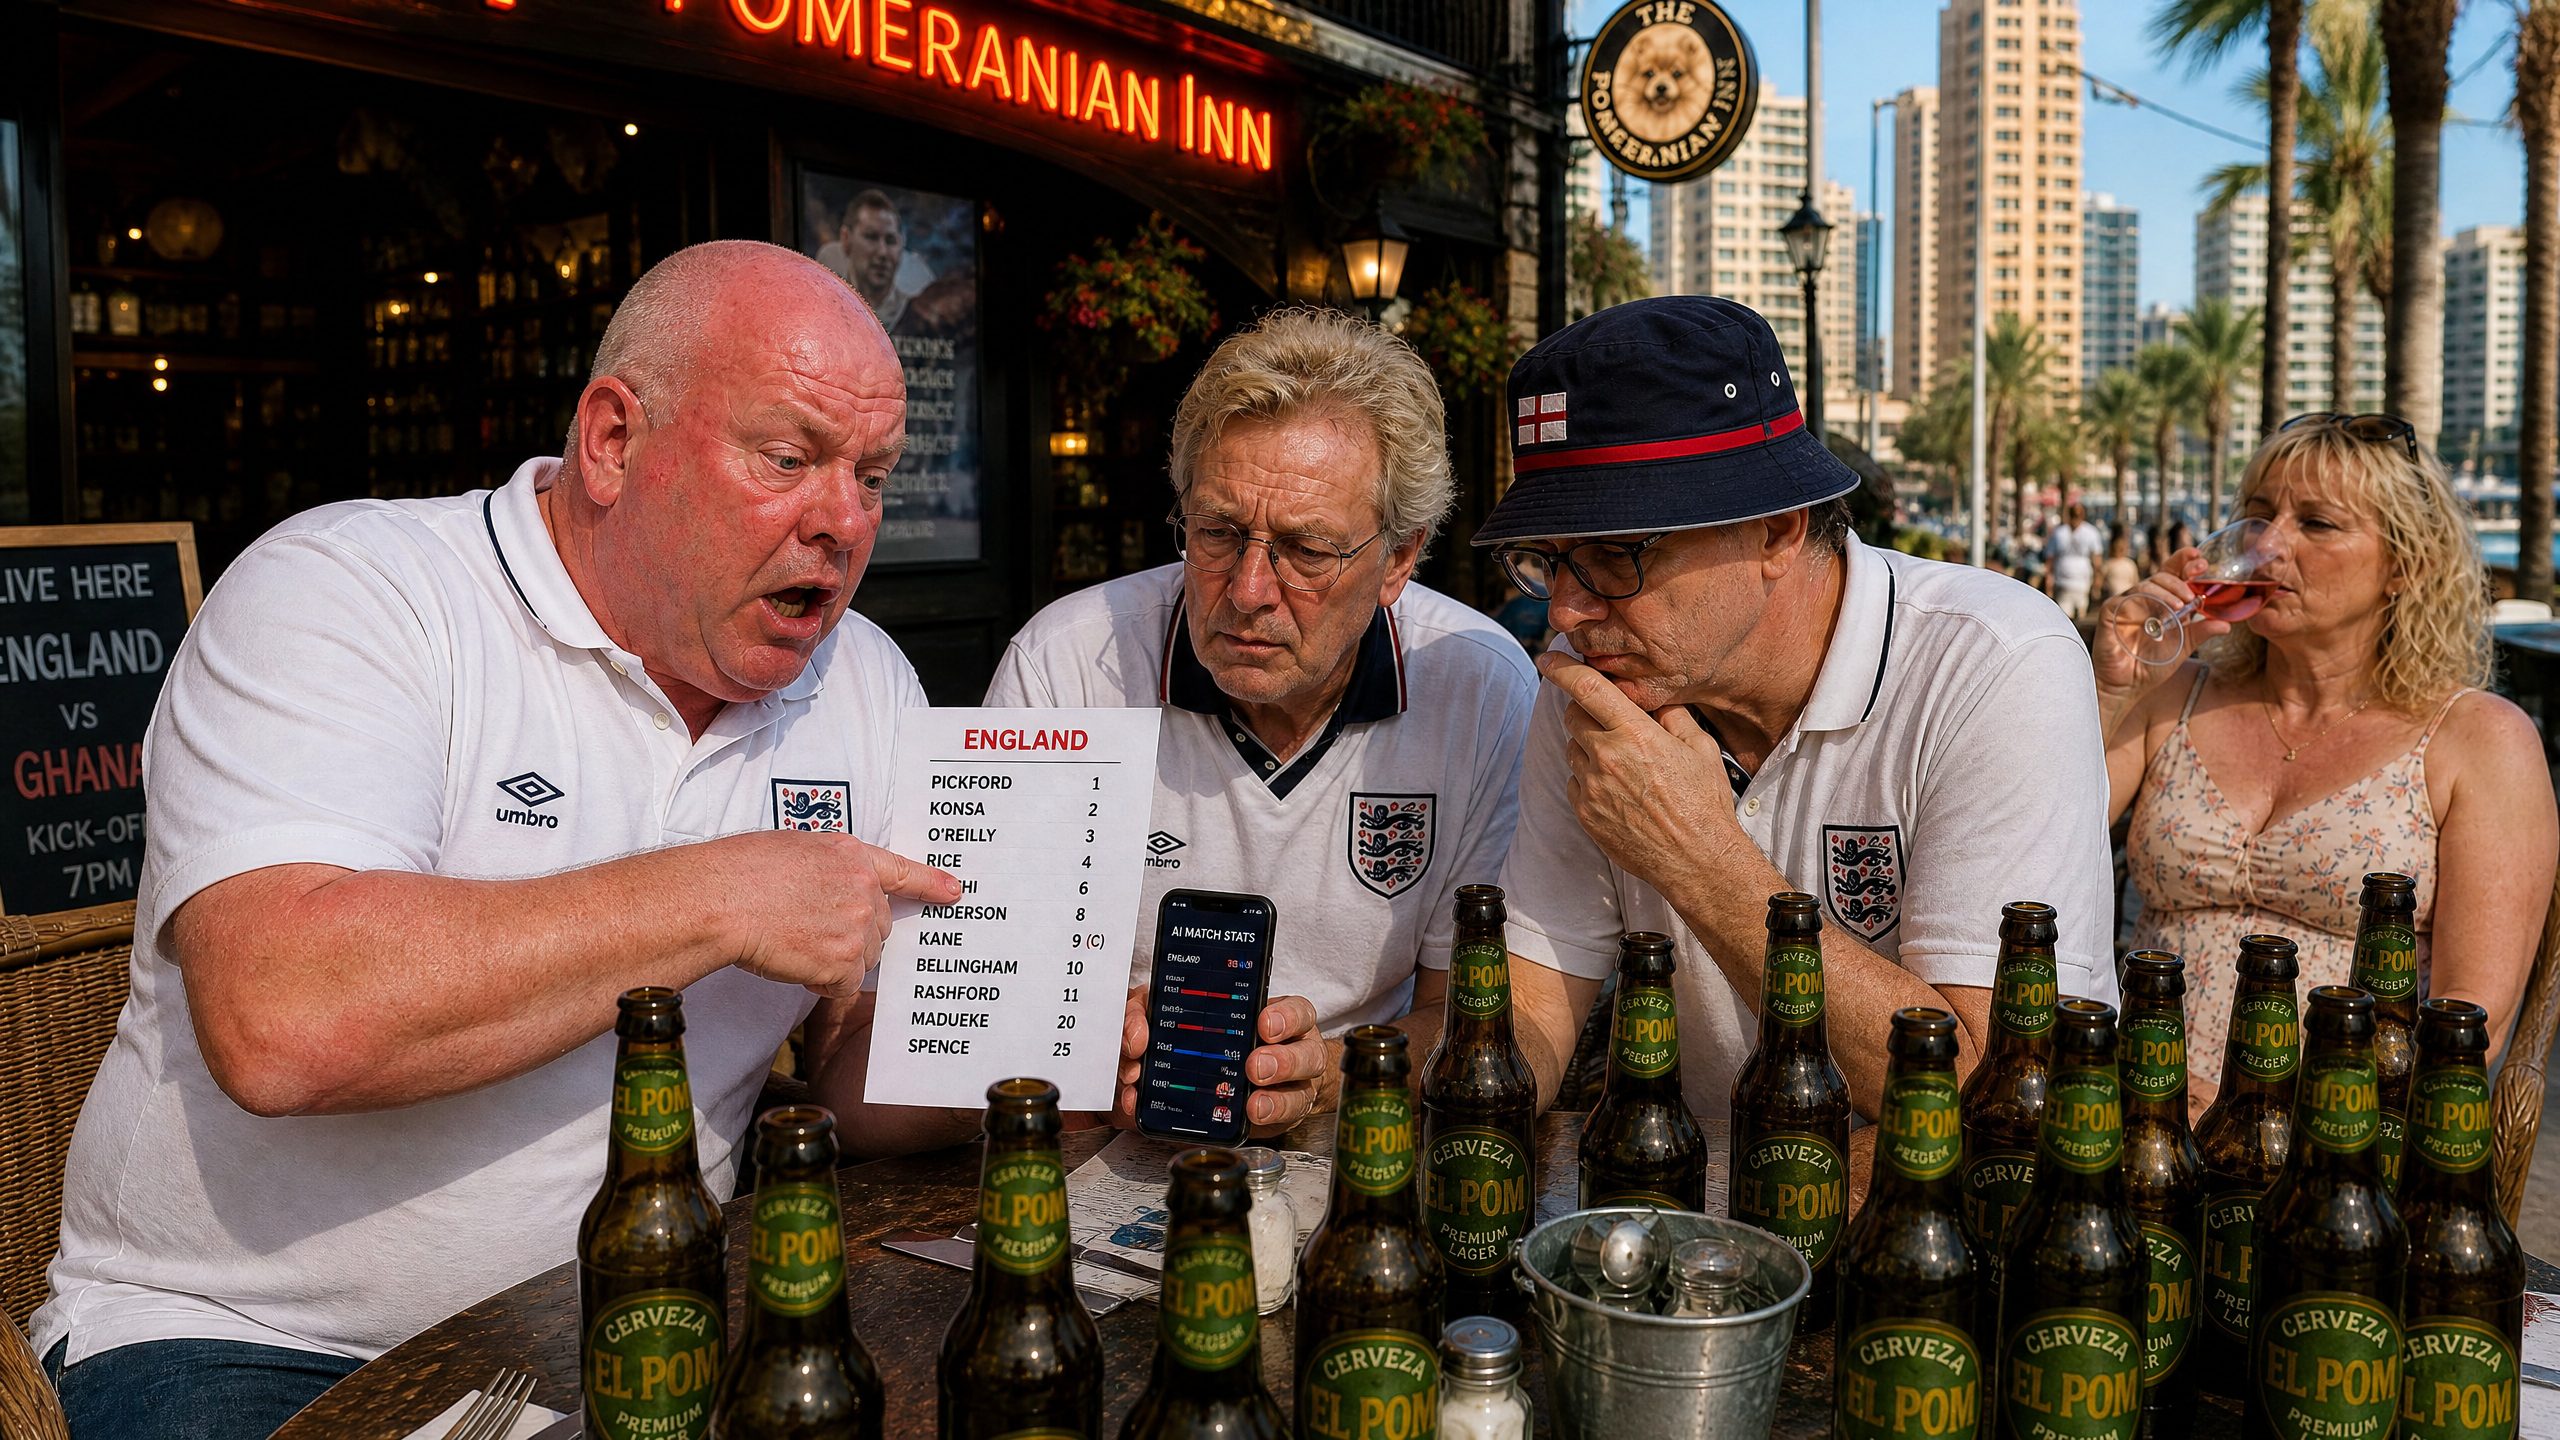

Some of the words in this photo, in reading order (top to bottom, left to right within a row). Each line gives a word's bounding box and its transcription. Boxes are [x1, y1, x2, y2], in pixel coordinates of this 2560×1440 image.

[1635, 1, 1697, 27] THE
[666, 0, 1160, 141] OMERANIAN
[1712, 57, 1738, 113] INN
[71, 562, 154, 601] HERE
[59, 702, 99, 731] VS
[963, 728, 1089, 751] ENGLAND
[931, 775, 1013, 790] PICKFORD
[1092, 776, 1100, 791] 1
[495, 807, 559, 829] umbro
[929, 801, 986, 816] KONSA
[1088, 802, 1098, 817] 2
[26, 812, 148, 856] KICK-OF
[928, 827, 997, 843] O'REILLY
[1085, 828, 1095, 843] 3
[926, 853, 962, 868] RICE
[1081, 855, 1092, 869] 4
[1145, 856, 1181, 869] mbro
[62, 857, 134, 900] 7PM
[1078, 881, 1089, 895] 6
[920, 905, 1007, 921] ANDERSON
[1075, 907, 1086, 922] 8
[918, 931, 963, 947] KANE
[1072, 933, 1082, 949] 9
[1085, 933, 1105, 950] (C)
[1171, 926, 1182, 937] AI
[1184, 927, 1222, 941] MATCH
[1224, 931, 1256, 943] STATS
[915, 957, 1018, 975] BELLINGHAM
[1066, 960, 1084, 976] 10
[1469, 962, 1508, 989] POM
[2378, 948, 2417, 973] POM
[913, 984, 1000, 1001] RASHFORD
[1063, 987, 1079, 1003] 11
[1784, 970, 1823, 995] POM
[2016, 981, 2057, 1007] POM
[911, 1011, 990, 1029] MADUEKE
[1056, 1014, 1076, 1030] 20
[1634, 1015, 1677, 1044] POM
[2255, 1021, 2299, 1049] POM
[908, 1038, 970, 1055] SPENCE
[1052, 1042, 1072, 1057] 25
[2142, 1039, 2185, 1067] POM
[640, 1080, 690, 1117] POM
[2328, 1082, 2378, 1114] POM
[1910, 1106, 1960, 1140] POM
[2071, 1099, 2120, 1133] POM
[2441, 1099, 2490, 1132] POM
[1364, 1119, 1412, 1155] POM
[1433, 1139, 1514, 1169] CERVEZA
[1749, 1144, 1832, 1175] CERVEZA
[1973, 1164, 2034, 1189] CERVE
[1011, 1186, 1066, 1229] POM
[1424, 1168, 1453, 1214] EL
[1459, 1174, 1525, 1217] POM
[1739, 1174, 1770, 1218] EL
[1776, 1178, 1841, 1221] POM
[779, 1221, 840, 1268] POM
[1440, 1223, 1509, 1245] PREMIUM
[1448, 1242, 1498, 1261] LAGER
[1196, 1271, 1255, 1319] POM
[2147, 1278, 2192, 1324] OM
[604, 1306, 707, 1343] CERVEZA
[2281, 1309, 2388, 1349] CERVEZA
[1860, 1335, 1966, 1376] CERVEZA
[2025, 1325, 2129, 1362] CERVEZA
[594, 1348, 632, 1400] EL
[640, 1338, 720, 1400] POM
[1323, 1346, 1426, 1382] CERVEZA
[2265, 1341, 2307, 1398] EL
[2315, 1354, 2398, 1406] POM
[1846, 1368, 1885, 1427] EL
[1893, 1379, 1976, 1437] POM
[2011, 1358, 2052, 1414] EL
[2060, 1366, 2138, 1420] POM
[2431, 1378, 2513, 1430] POM
[616, 1402, 702, 1434] PREMIUM
[1310, 1383, 1350, 1440] EL
[1358, 1383, 1437, 1440] POM
[2287, 1406, 2379, 1437] PREMIUM
